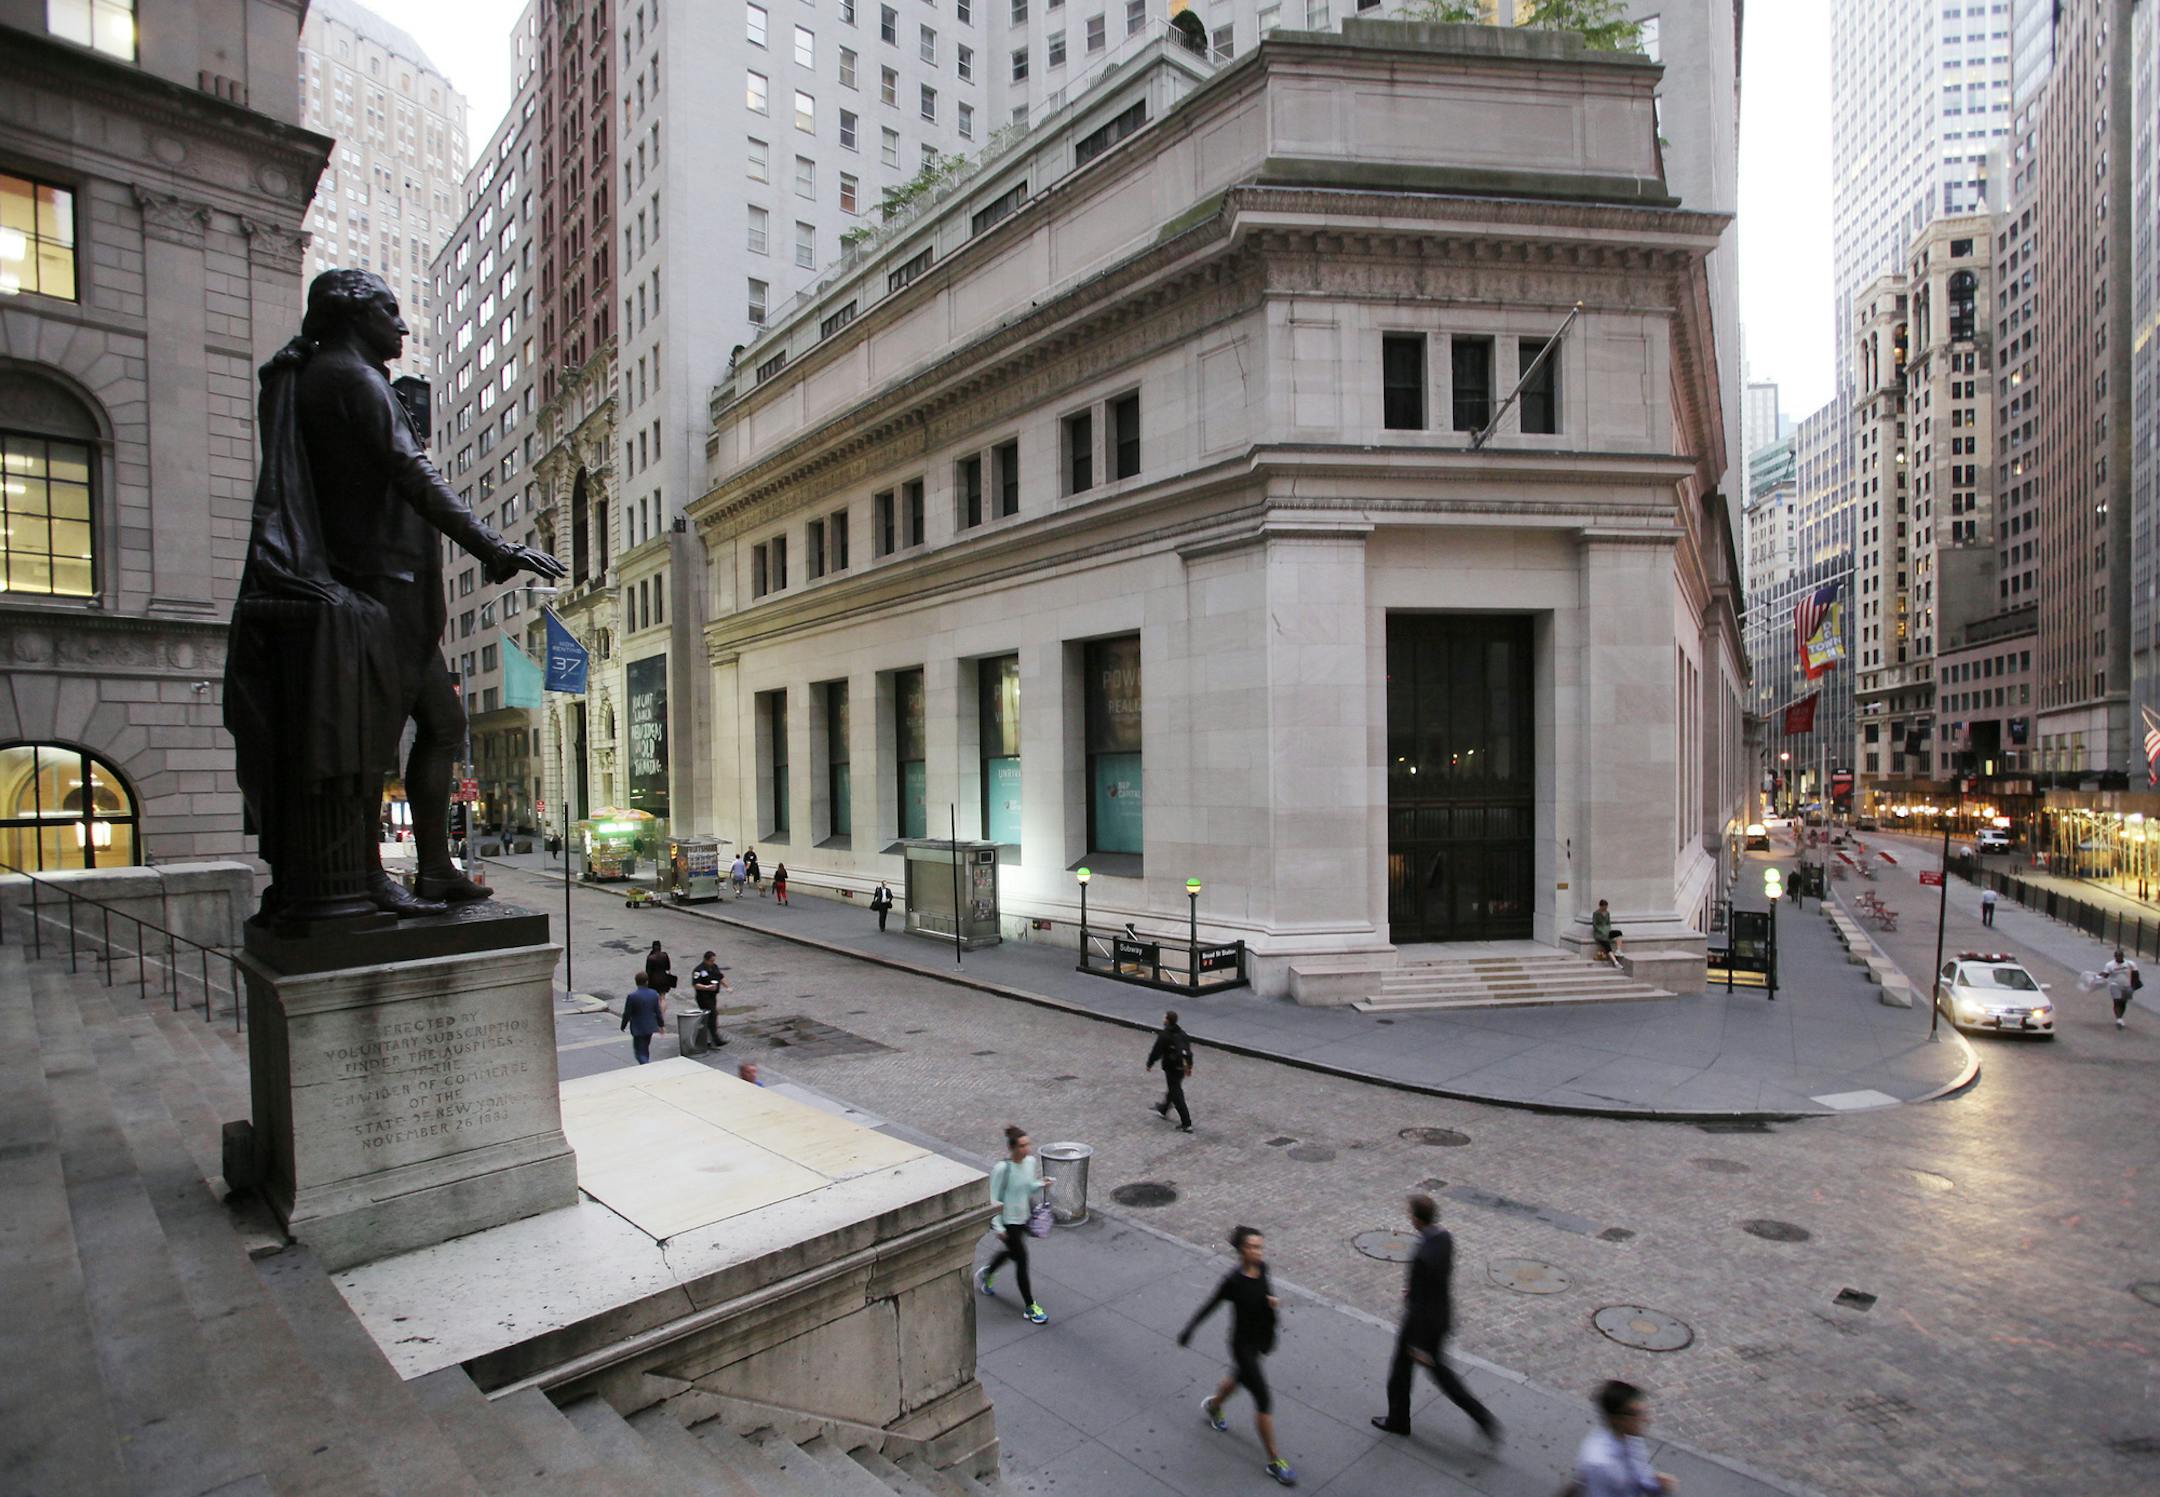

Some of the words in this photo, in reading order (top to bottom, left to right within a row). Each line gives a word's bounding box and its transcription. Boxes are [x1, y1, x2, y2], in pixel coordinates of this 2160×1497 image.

[552, 656, 581, 680] 37
[1103, 670, 1142, 689] POW
[643, 723, 662, 742] IDEAS
[1120, 943, 1143, 955] Subway
[384, 1015, 456, 1037] ERECTED
[461, 1010, 478, 1023] BY
[326, 1036, 419, 1061] VOLUNTARY
[425, 1018, 529, 1044] SUBSCRIPTION
[409, 1048, 438, 1064] THE
[433, 1058, 463, 1074] THE
[418, 1079, 436, 1092] OF
[409, 1096, 428, 1110] OF
[436, 1089, 463, 1105] THE
[354, 1117, 405, 1136] STATE
[436, 1101, 473, 1119] NEW
[362, 1123, 449, 1150] NOVEMBER
[455, 1118, 473, 1133] 26
